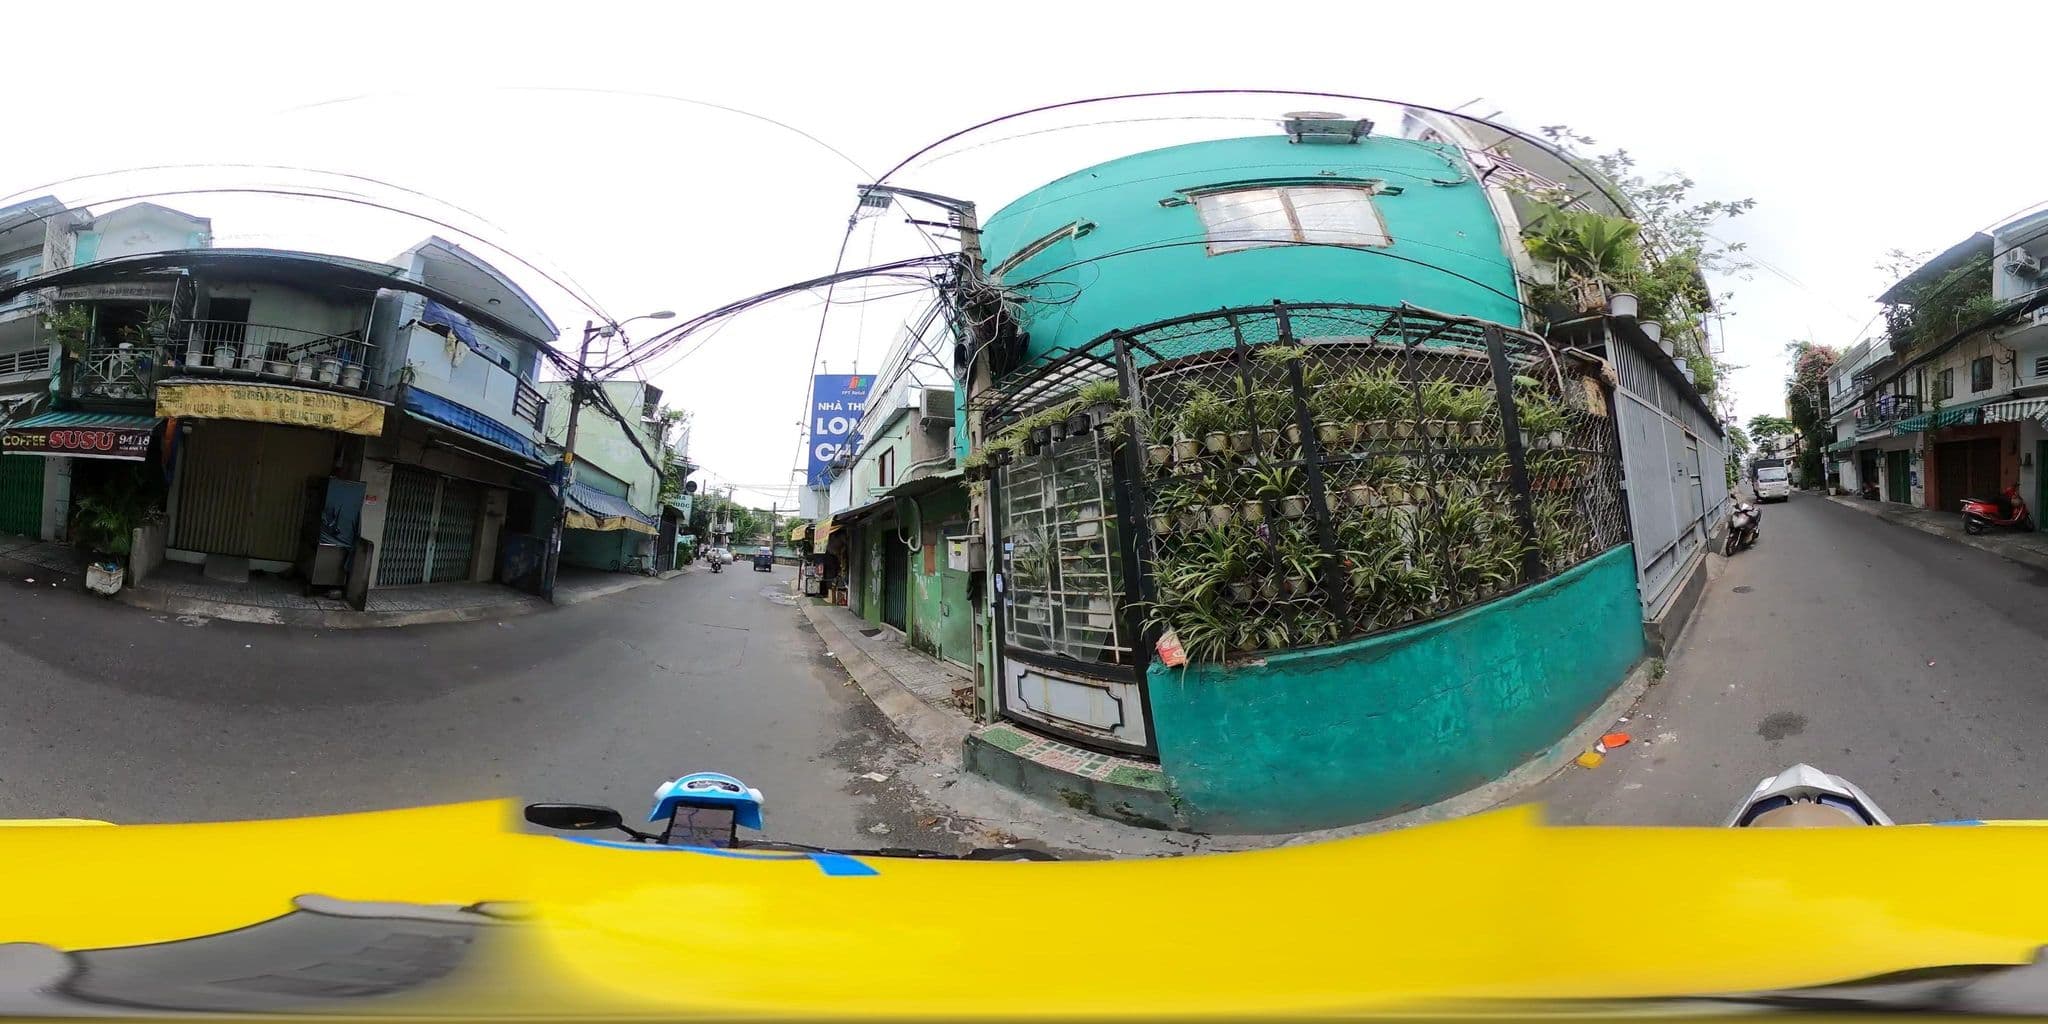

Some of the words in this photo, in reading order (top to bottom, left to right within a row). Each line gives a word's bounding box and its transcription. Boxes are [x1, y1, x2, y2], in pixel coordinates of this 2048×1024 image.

[818, 400, 843, 411] NHÀ
[2, 435, 46, 447] COFFEE
[49, 430, 115, 450] SUSU
[118, 434, 150, 446] 94/18
